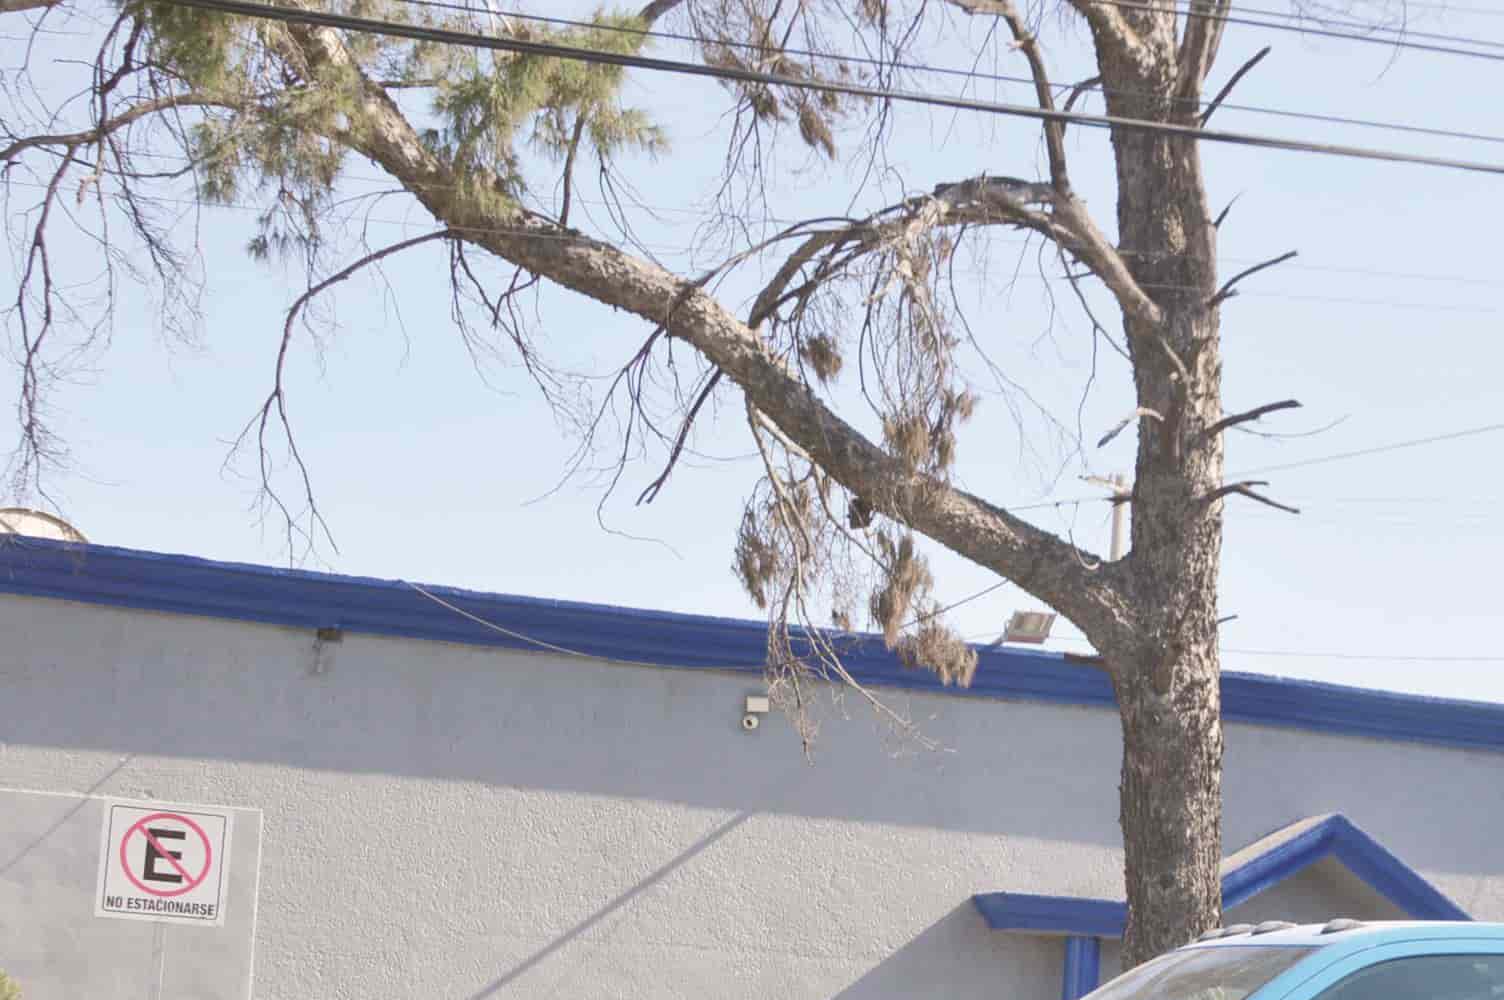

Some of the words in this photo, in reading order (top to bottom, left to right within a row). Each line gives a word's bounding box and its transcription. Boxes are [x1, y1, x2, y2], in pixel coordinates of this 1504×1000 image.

[143, 828, 186, 883] E
[106, 896, 122, 908] NO
[127, 898, 214, 915] ESTACIONARSE
